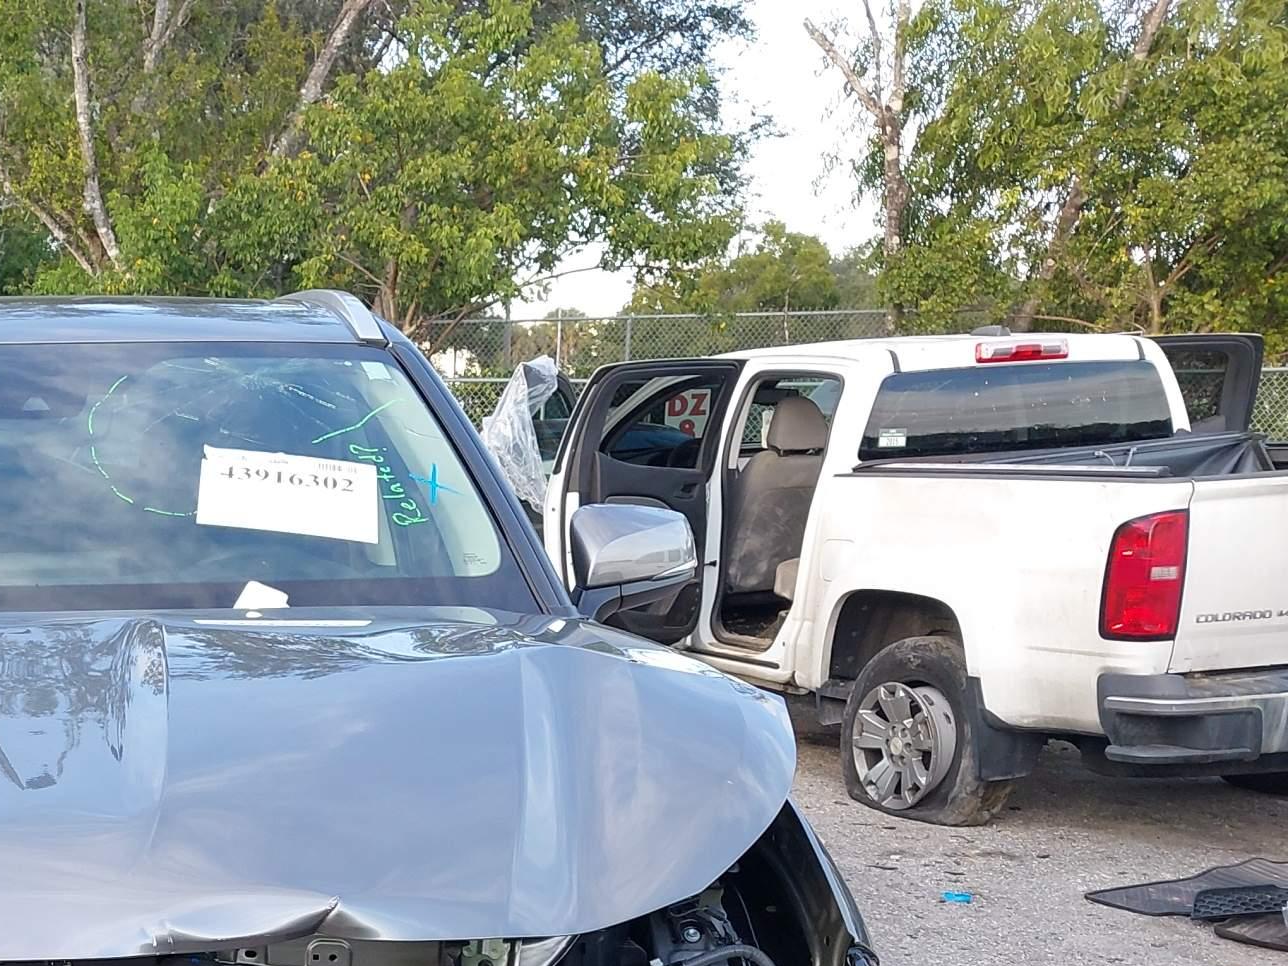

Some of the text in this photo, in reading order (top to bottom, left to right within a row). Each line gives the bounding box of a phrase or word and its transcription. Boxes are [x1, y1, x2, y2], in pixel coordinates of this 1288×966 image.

[667, 393, 709, 417] DZ
[220, 465, 355, 493] 43916302
[1195, 609, 1273, 624] COLORADO
